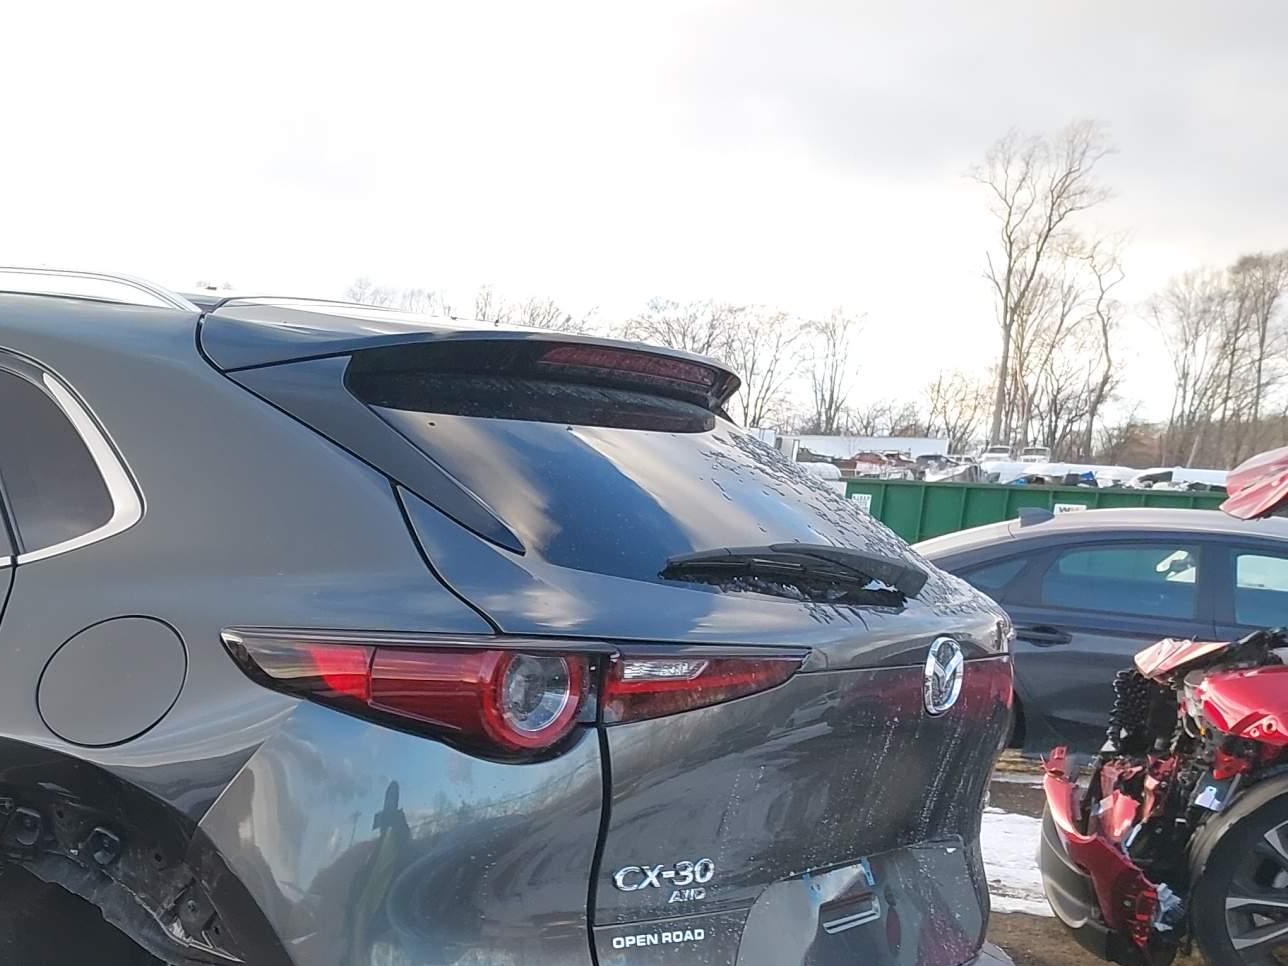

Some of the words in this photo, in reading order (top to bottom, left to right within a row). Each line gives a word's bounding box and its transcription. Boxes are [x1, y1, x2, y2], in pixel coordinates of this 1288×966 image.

[613, 858, 715, 892] CX-30
[668, 887, 707, 904] AWD
[612, 933, 659, 949] OPEN
[661, 928, 705, 944] ROAD
